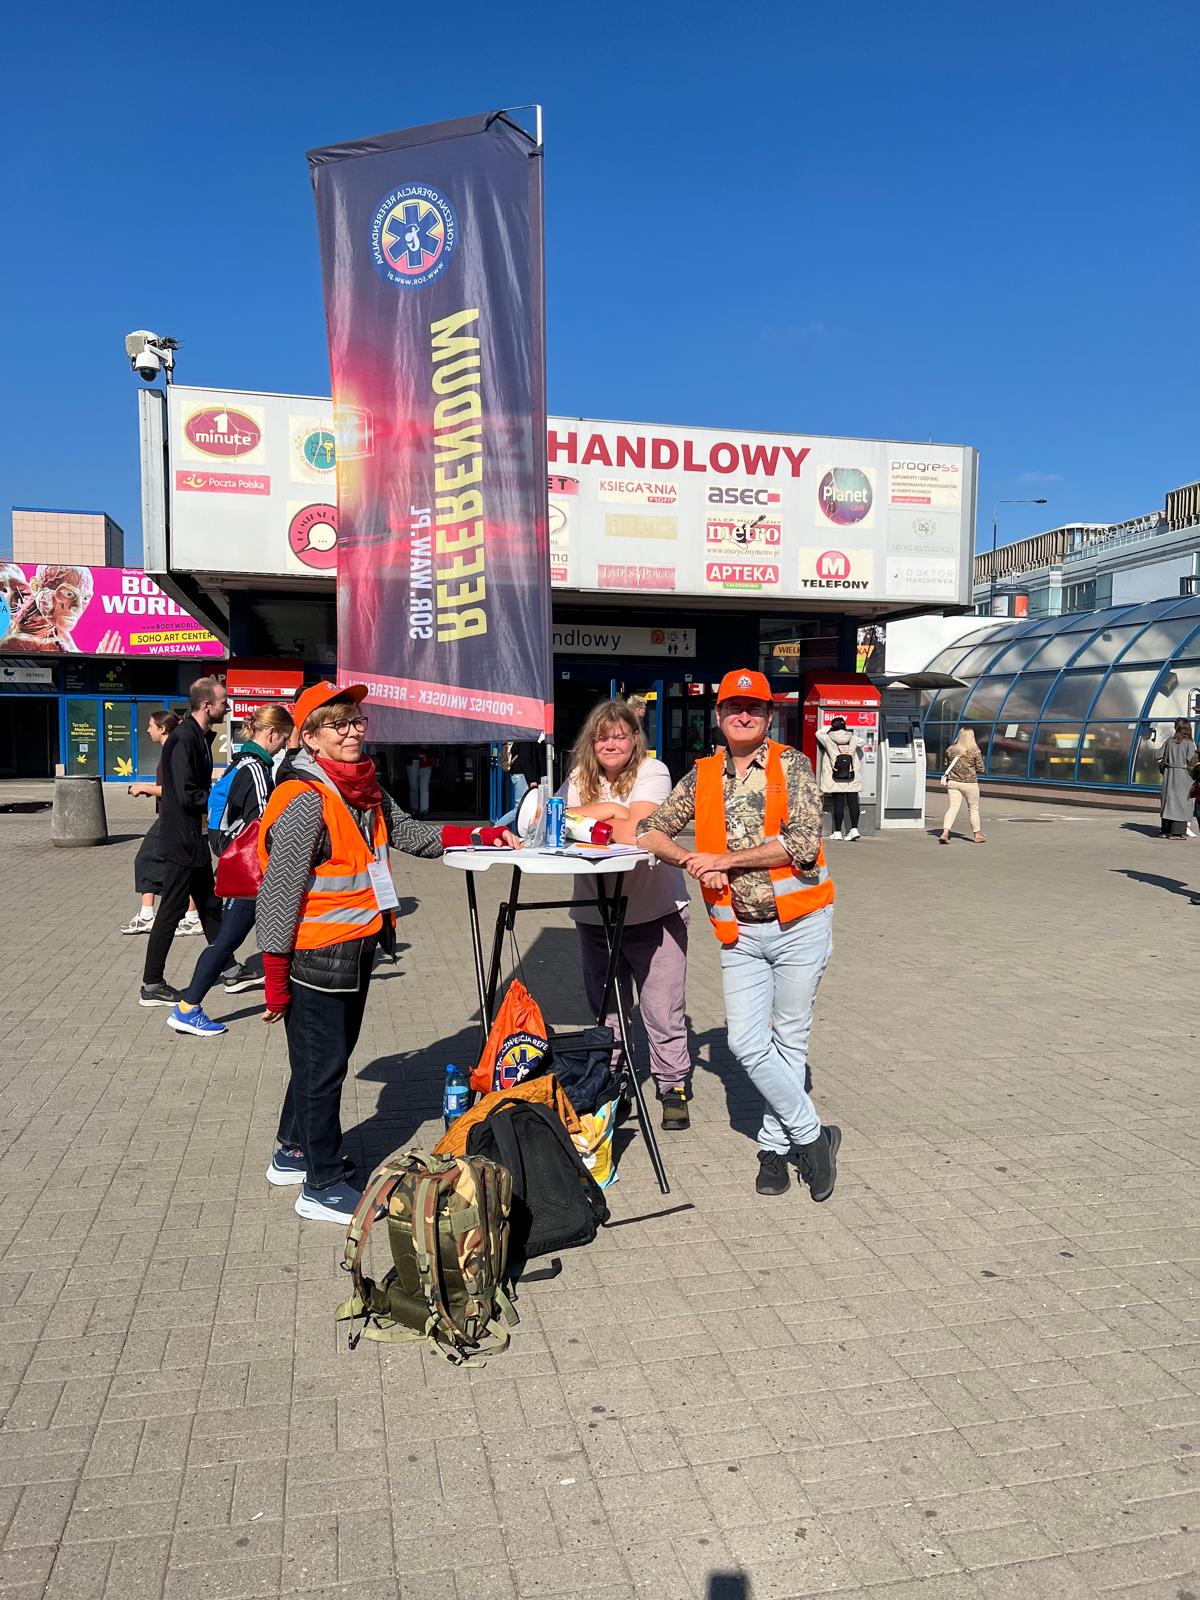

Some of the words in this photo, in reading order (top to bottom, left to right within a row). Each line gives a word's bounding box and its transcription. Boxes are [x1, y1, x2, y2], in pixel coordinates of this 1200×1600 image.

[213, 413, 228, 433] 1
[195, 430, 252, 446] minute
[547, 430, 811, 478] HANDLOWY
[891, 461, 959, 473] progress
[208, 478, 237, 489] Poczta
[238, 479, 265, 490] Polska
[600, 480, 677, 496] KSIĘGARNIA
[708, 487, 768, 505] asec
[823, 487, 868, 503] Planet
[707, 524, 780, 542] metro
[710, 565, 776, 581] APTEKA
[906, 569, 954, 577] DOKTOR
[122, 576, 167, 596] BO
[801, 579, 869, 589] TELEFONY
[101, 595, 191, 616] WORL
[137, 634, 162, 643] SOHO
[164, 633, 179, 642] ART
[181, 631, 213, 641] CENTER
[149, 644, 201, 654] WARSZAWA
[234, 703, 260, 713] Bilet
